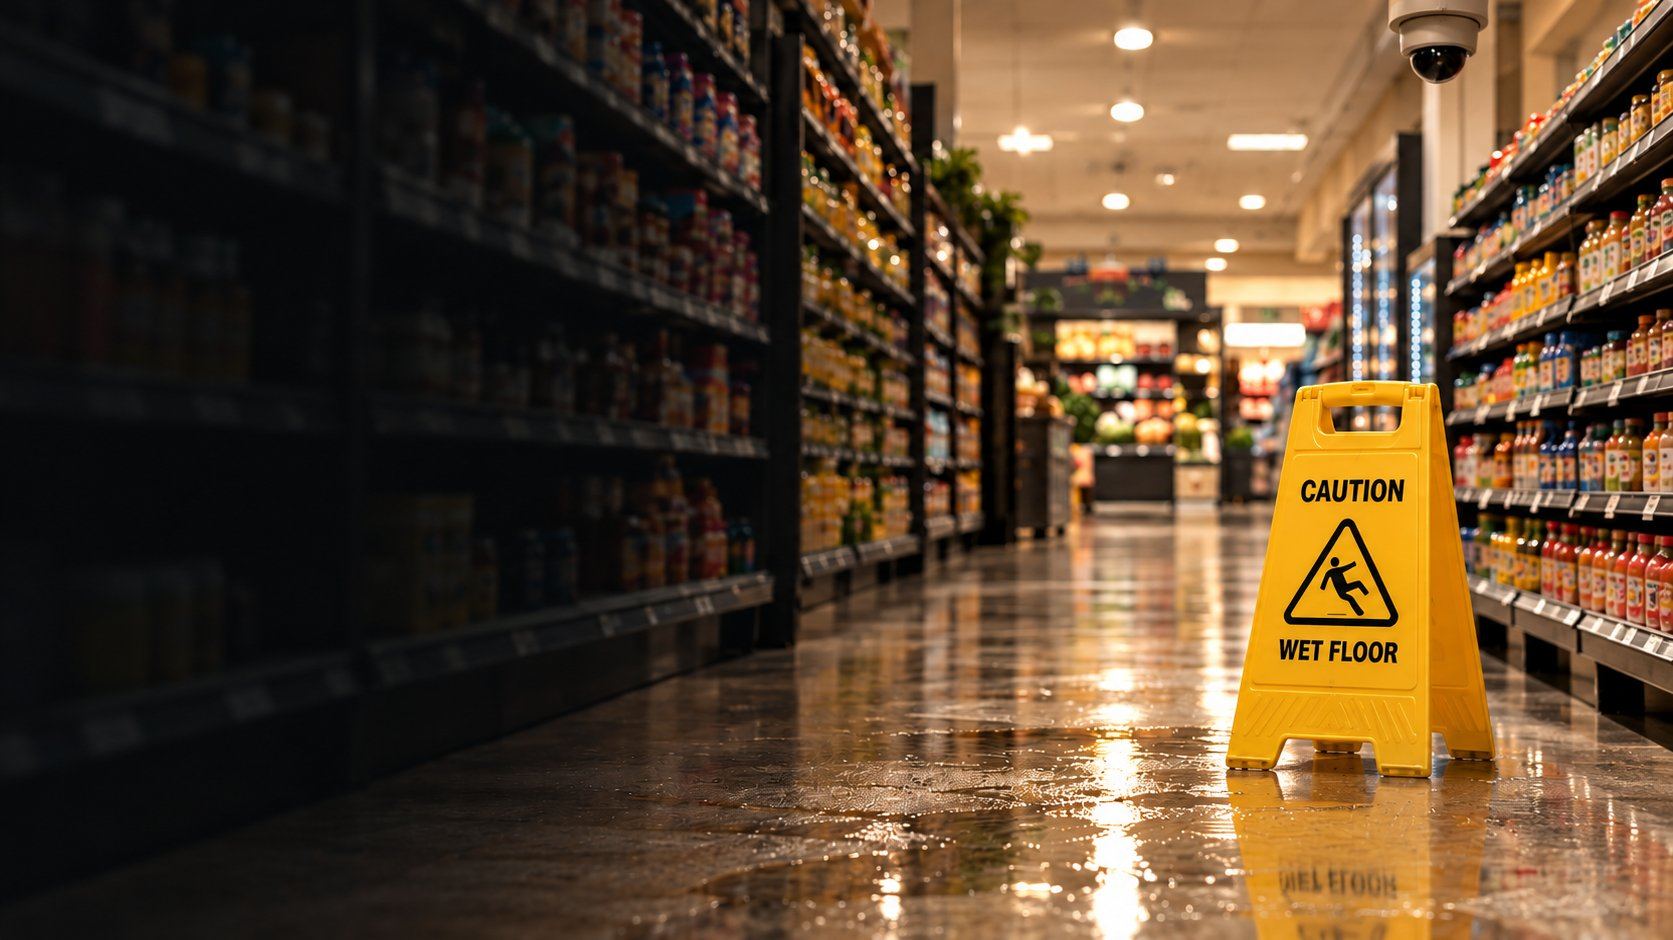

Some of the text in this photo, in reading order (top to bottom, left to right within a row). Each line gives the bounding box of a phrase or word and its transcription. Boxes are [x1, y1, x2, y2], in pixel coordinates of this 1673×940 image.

[1300, 479, 1405, 503] CAUTION
[1279, 639, 1398, 664] WET FLOOR
